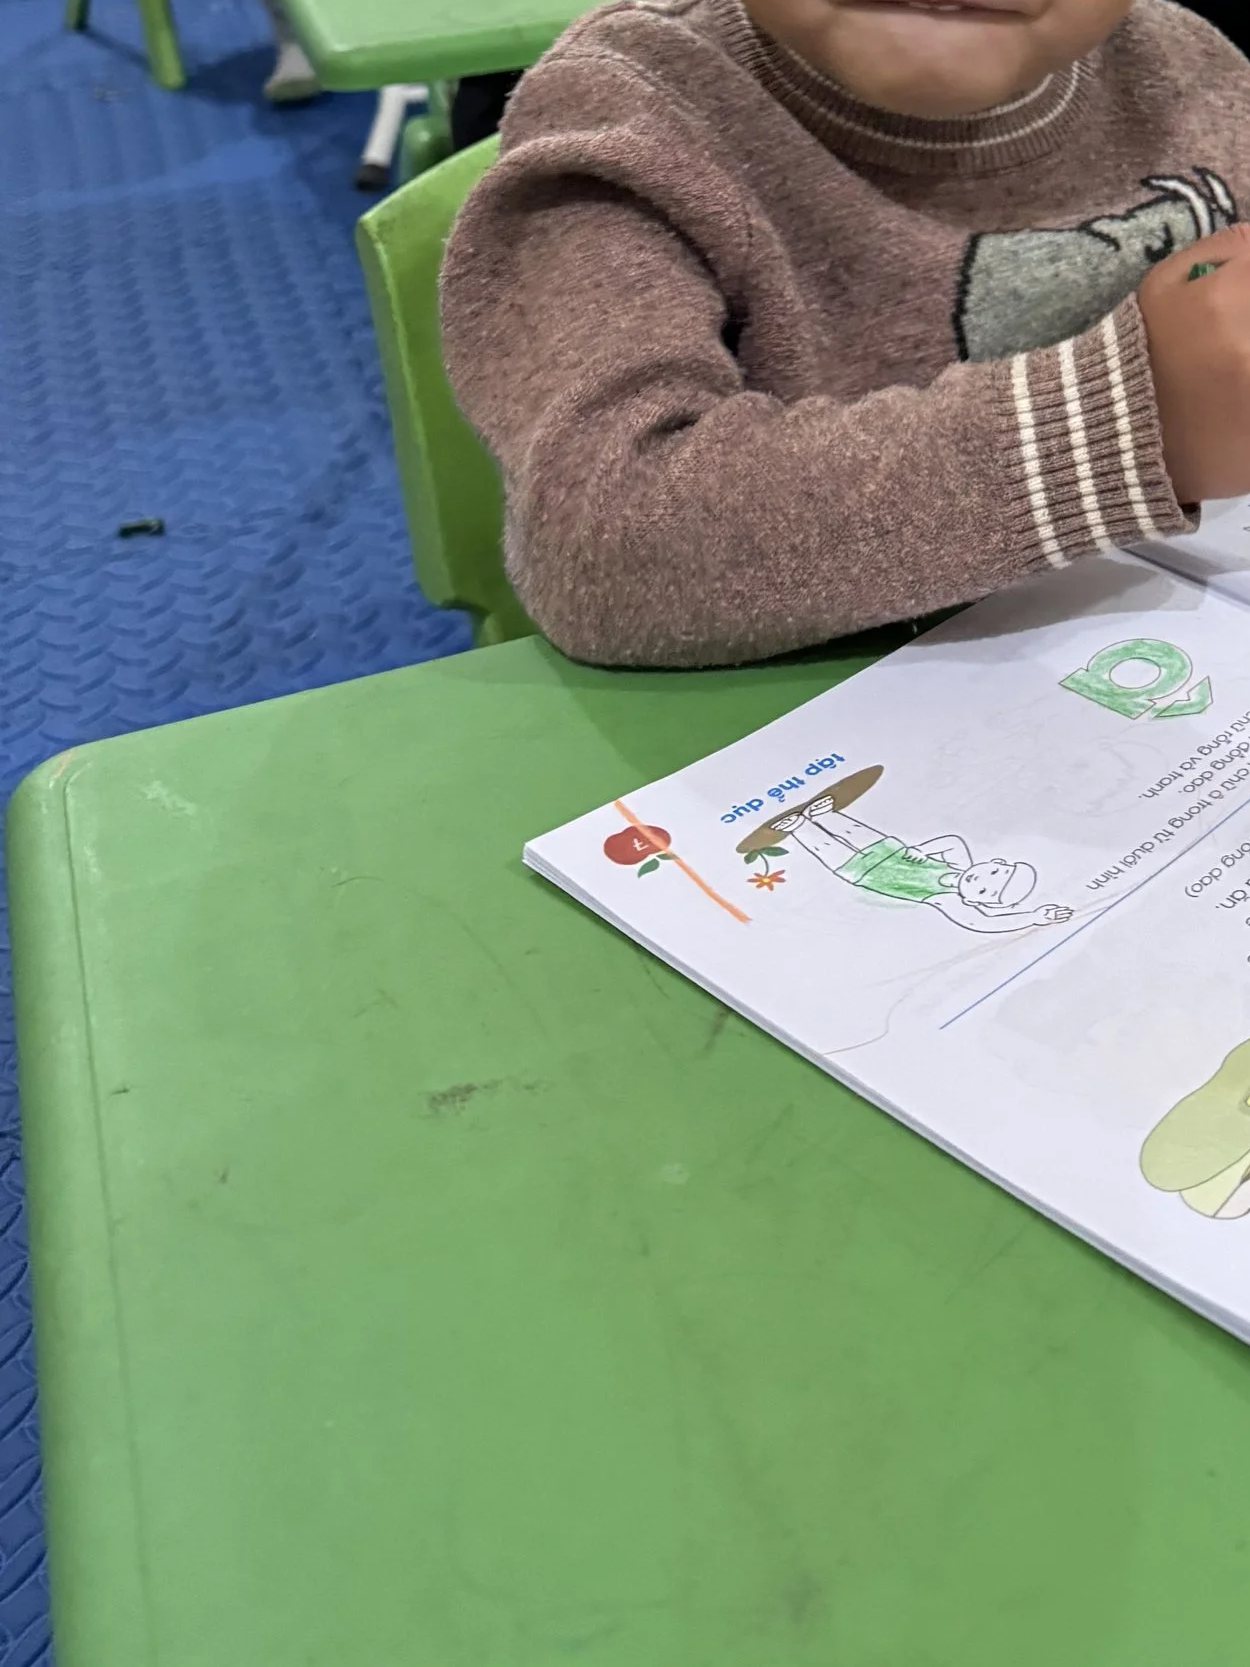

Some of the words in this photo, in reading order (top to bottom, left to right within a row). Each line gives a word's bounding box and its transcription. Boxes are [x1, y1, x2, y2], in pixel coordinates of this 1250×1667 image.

[1196, 730, 1233, 755] rỗng
[804, 753, 845, 775] tập
[1178, 756, 1202, 770] và
[1209, 741, 1249, 770] đồng
[766, 776, 805, 803] thể
[1138, 770, 1184, 798] tranh.
[1177, 770, 1214, 793] dao.
[1219, 767, 1249, 791] chữ
[720, 798, 763, 823] dục
[1167, 799, 1213, 829] trong
[632, 838, 648, 851] 7
[1152, 828, 1175, 843] từ
[1118, 841, 1155, 868] dưới
[1085, 865, 1125, 889] hình
[1184, 867, 1222, 897] dao)
[1215, 889, 1250, 908] ăn.
